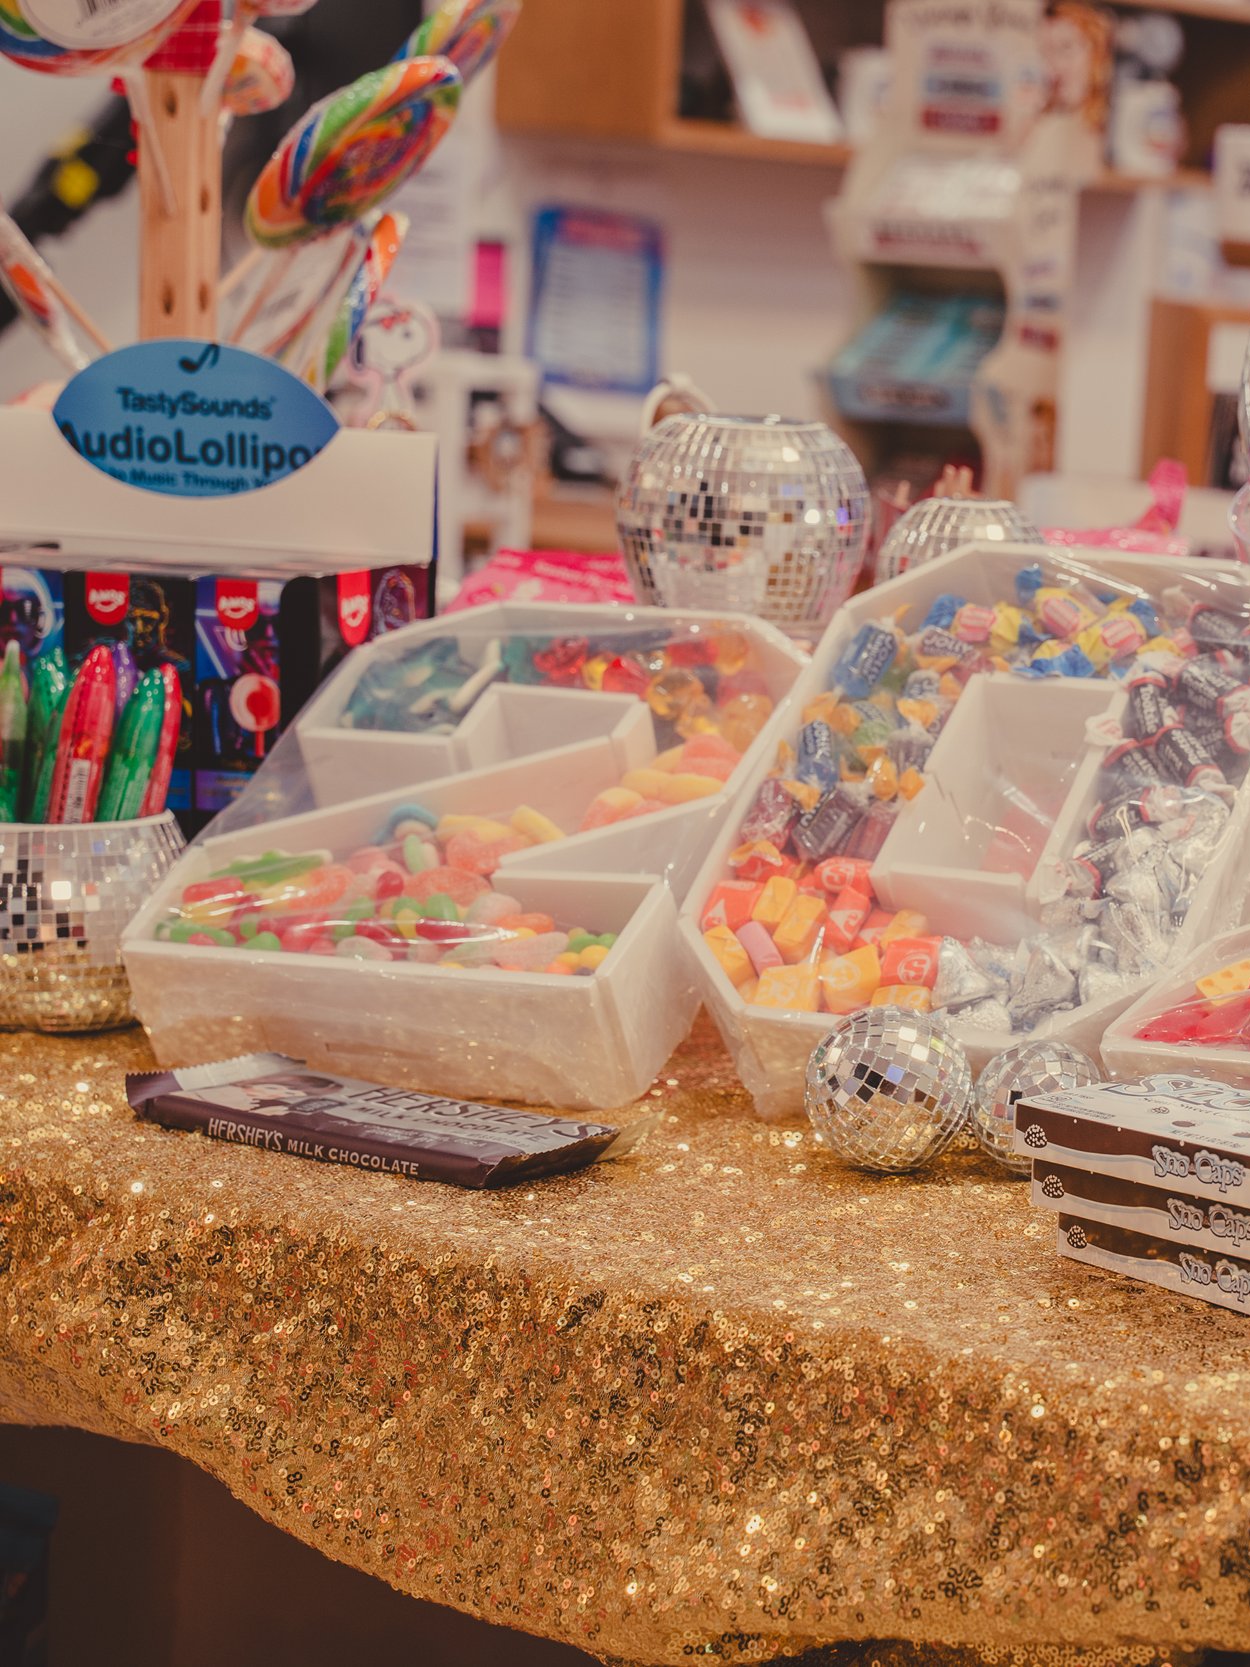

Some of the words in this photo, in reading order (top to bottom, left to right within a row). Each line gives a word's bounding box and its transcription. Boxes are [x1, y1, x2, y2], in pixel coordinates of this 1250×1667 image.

[116, 387, 272, 420] TastySounds
[357, 1106, 411, 1121] MILK
[416, 1115, 550, 1142] CHOCOLATE
[208, 1117, 284, 1152] HERSHEY'S
[287, 1138, 325, 1158] MILK
[328, 1147, 420, 1176] CHOCOLATE
